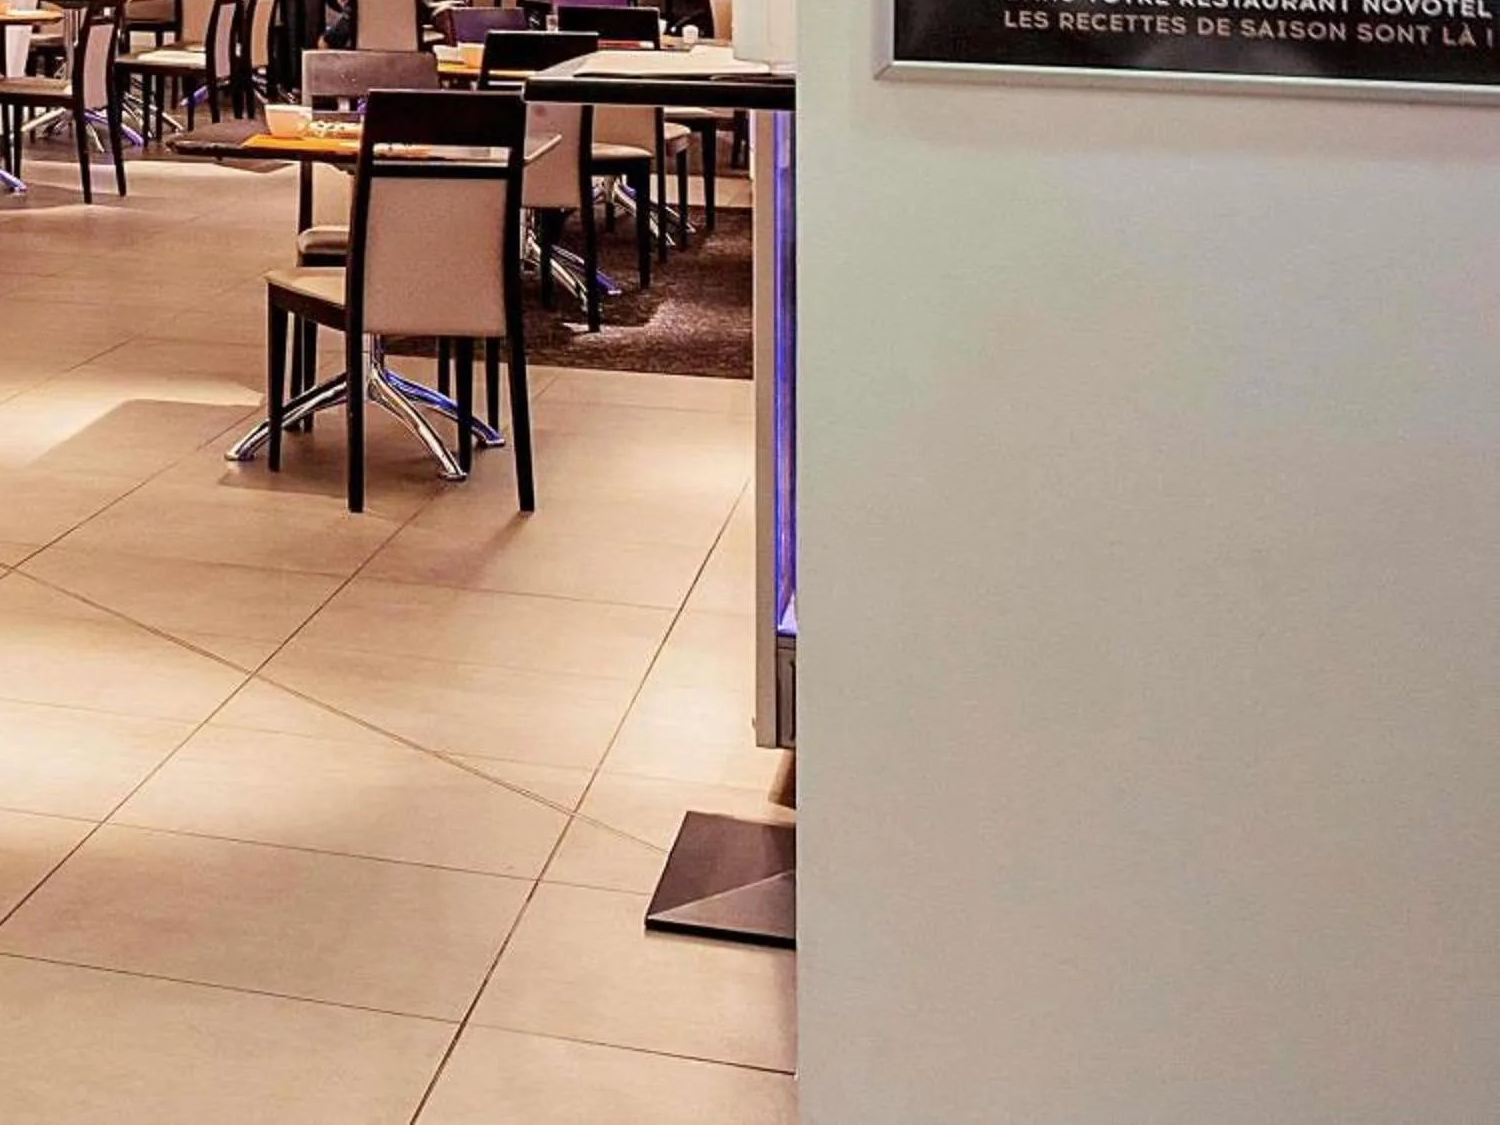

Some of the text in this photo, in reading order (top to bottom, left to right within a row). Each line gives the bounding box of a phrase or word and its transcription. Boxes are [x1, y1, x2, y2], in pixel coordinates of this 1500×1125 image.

[1004, 10, 1049, 29] LES
[1058, 11, 1187, 35] RECETTES
[1197, 16, 1232, 37] DE
[1240, 18, 1348, 42] SAISON
[1356, 23, 1432, 45] SONT
[1442, 21, 1477, 47] LÀ
